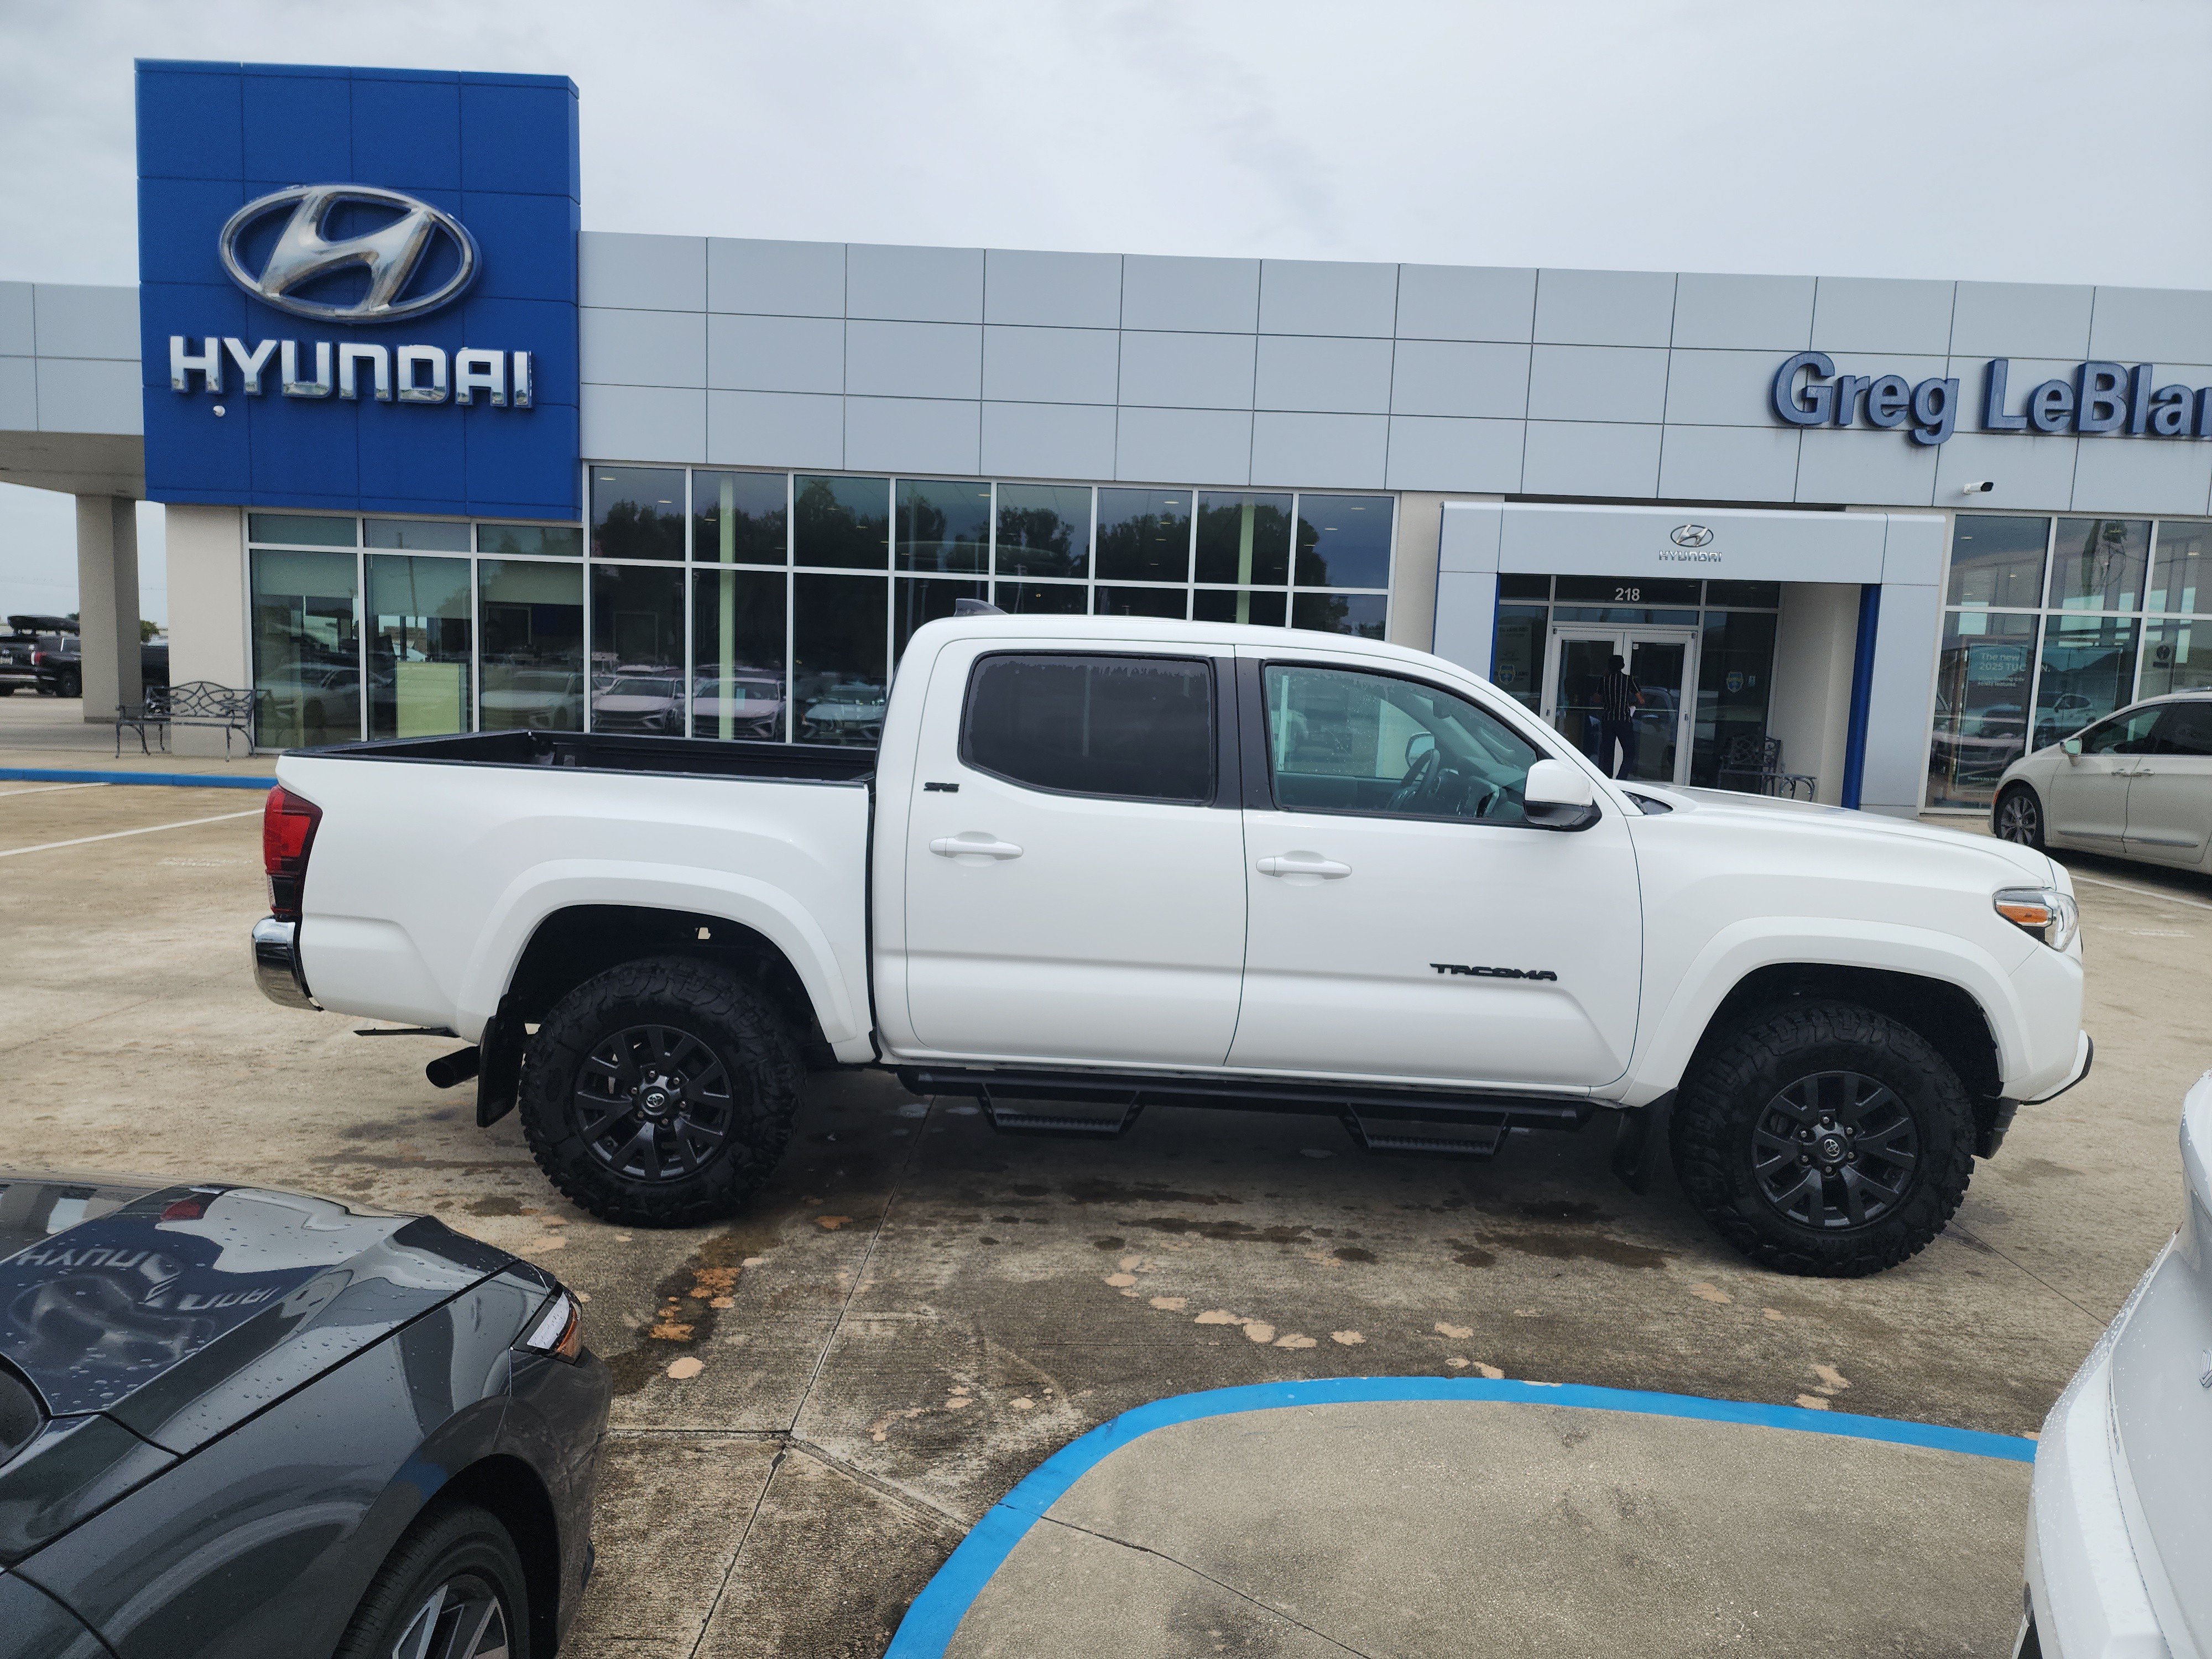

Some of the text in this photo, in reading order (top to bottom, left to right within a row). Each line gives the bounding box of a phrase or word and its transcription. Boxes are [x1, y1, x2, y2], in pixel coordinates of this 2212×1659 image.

[169, 335, 534, 409] HYUNDAI
[1770, 351, 1960, 446] Greg
[1659, 550, 1722, 562] HYUNDAI
[1615, 587, 1640, 602] 218
[1430, 963, 1558, 981] TACOMA
